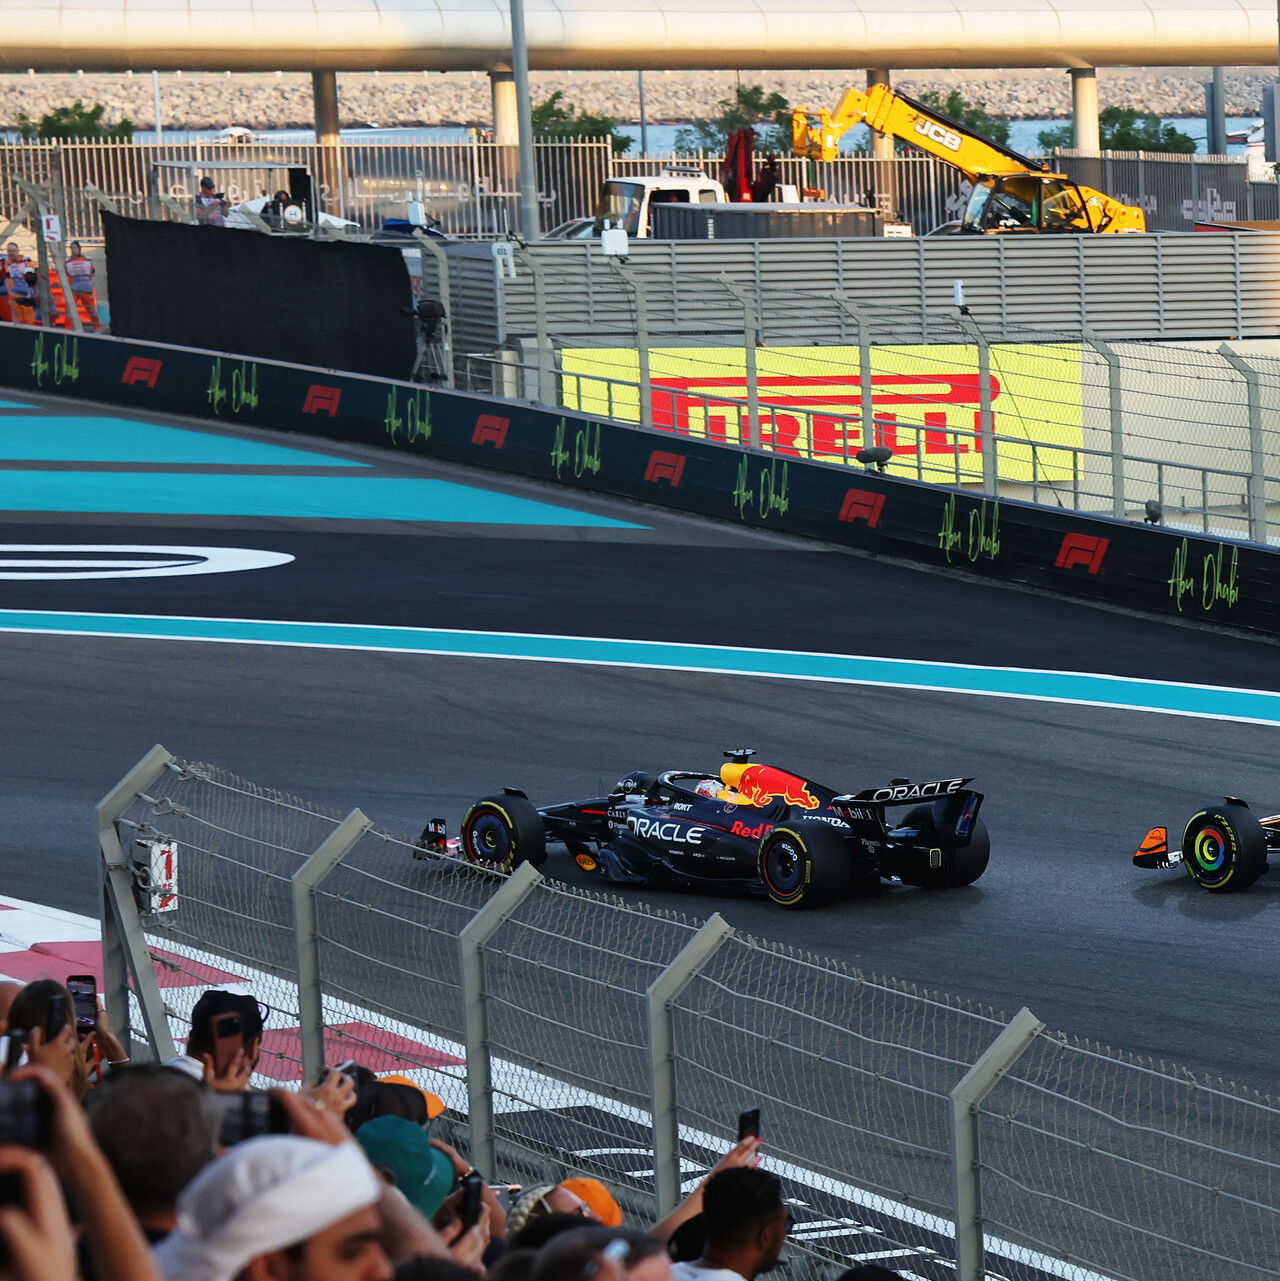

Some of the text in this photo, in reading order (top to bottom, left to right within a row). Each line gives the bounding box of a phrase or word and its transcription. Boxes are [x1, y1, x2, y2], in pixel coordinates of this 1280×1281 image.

[914, 117, 962, 152] JCB
[650, 374, 1001, 457] PIRELLI
[732, 451, 789, 519] Abu Dhabi
[937, 494, 1000, 562] Abu Dhabi
[1168, 538, 1239, 611] Abu Dhabi
[872, 779, 964, 802] ORACLE
[673, 803, 693, 812] ROKT
[834, 806, 864, 820] Mobil
[627, 816, 706, 844] ORACLE
[730, 820, 764, 839] Red
